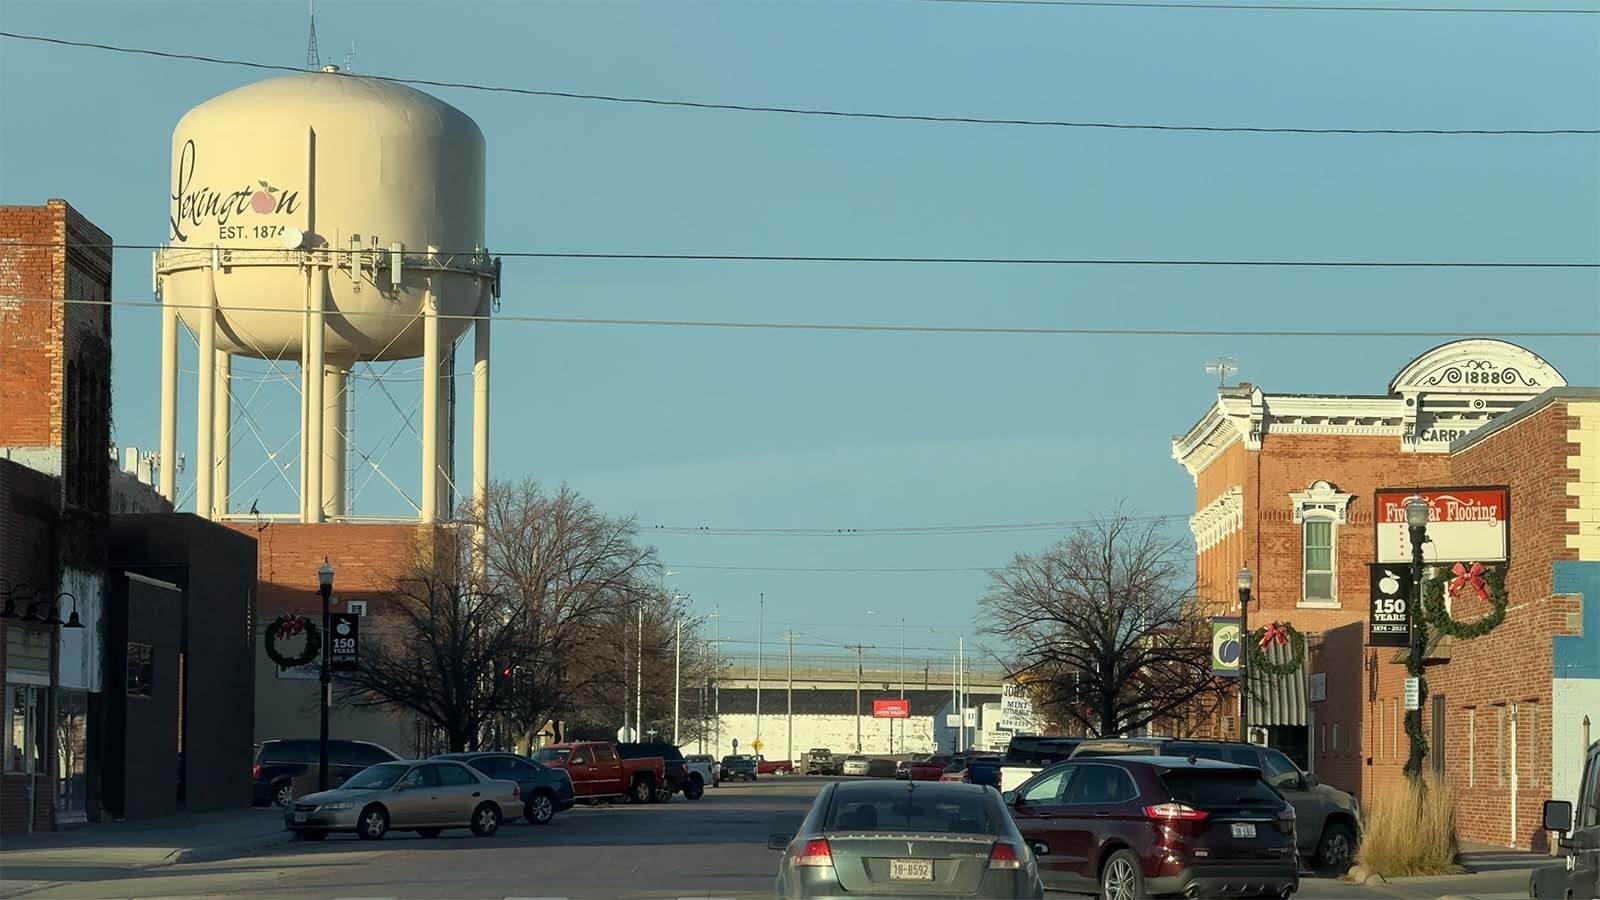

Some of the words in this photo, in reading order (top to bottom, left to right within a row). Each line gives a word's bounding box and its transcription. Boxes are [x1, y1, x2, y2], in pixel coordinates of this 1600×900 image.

[219, 226, 248, 239] EST.
[1465, 371, 1500, 384] 1888
[1446, 502, 1497, 522] Flooring
[1374, 598, 1406, 614] 150
[1374, 613, 1406, 621] YEARS
[333, 637, 356, 649] 150
